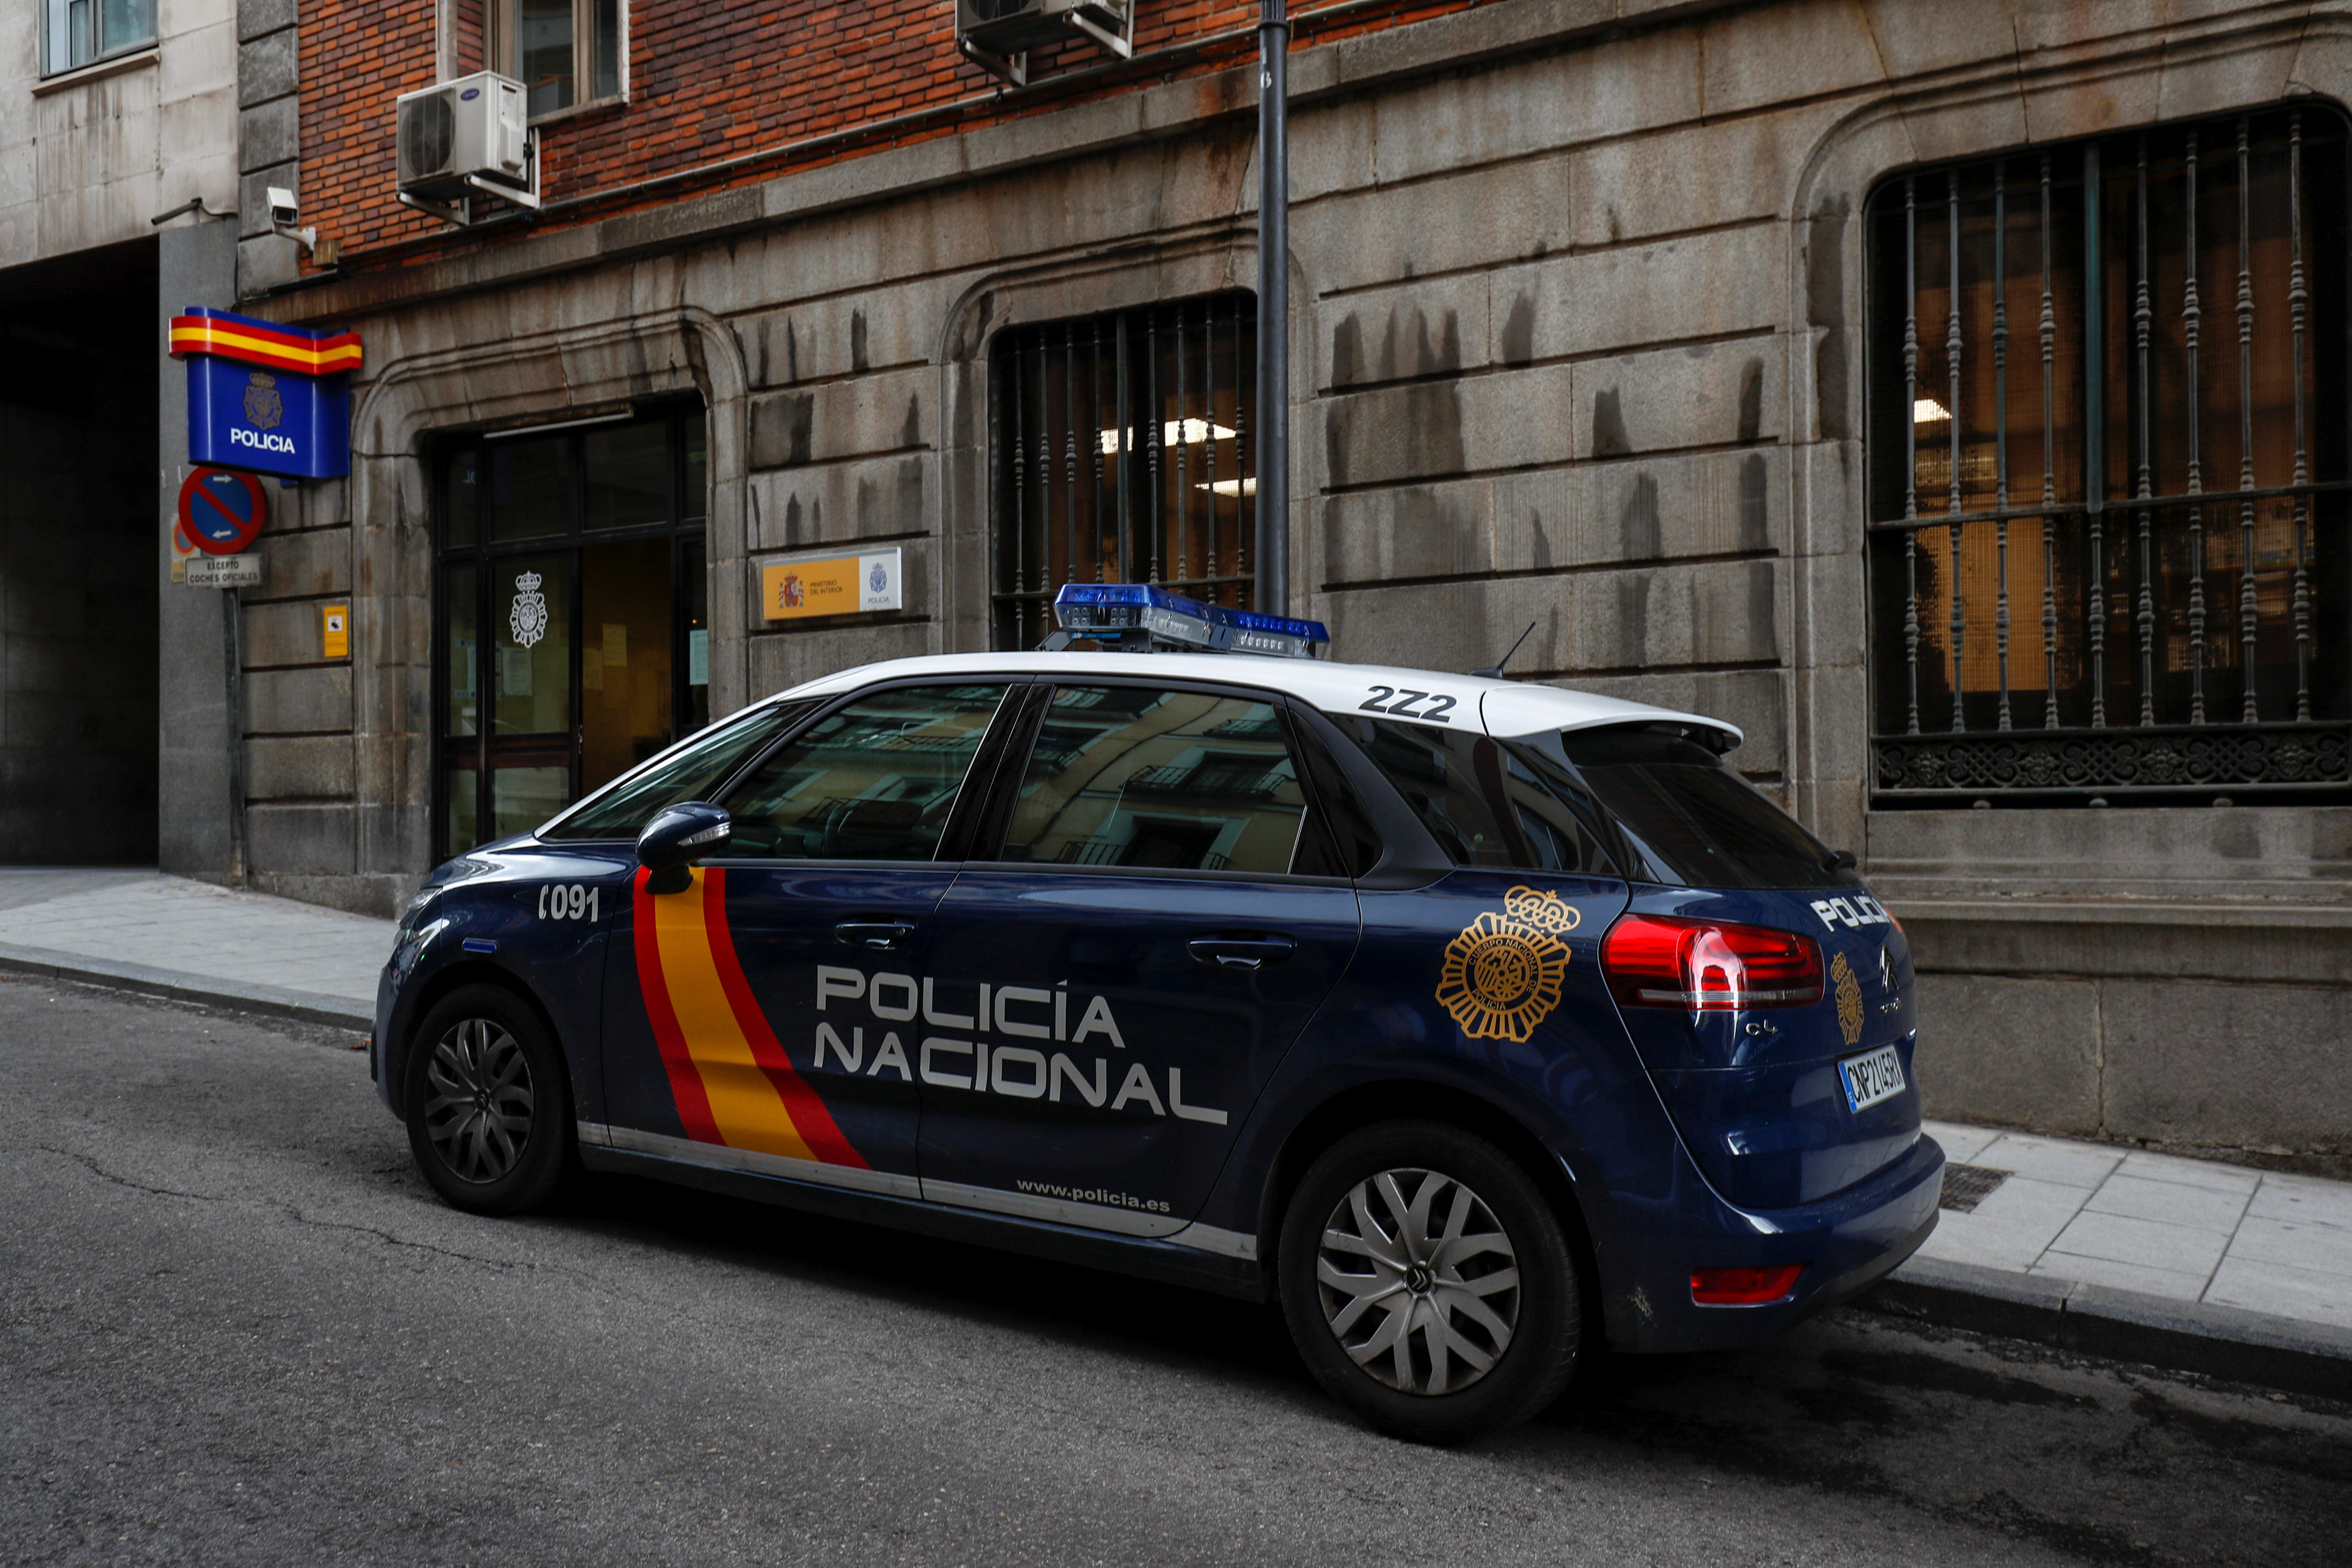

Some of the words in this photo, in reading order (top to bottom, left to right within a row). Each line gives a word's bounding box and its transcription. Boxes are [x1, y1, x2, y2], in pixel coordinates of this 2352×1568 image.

[230, 427, 296, 454] POLICIA
[190, 573, 219, 583] COCHES
[222, 572, 258, 582] OFICIALES
[207, 561, 239, 570] EXCEPTO
[810, 580, 837, 588] MINISTERIO
[810, 588, 818, 596] DEL
[821, 586, 843, 595] INTERIOR
[1358, 685, 1457, 723] 2Z2
[550, 884, 599, 922] 091
[1468, 939, 1503, 965] CUERPO
[1506, 939, 1538, 977] NACIONAL
[1526, 979, 1537, 994] DE
[816, 965, 1126, 1049] POLICÍA
[813, 1022, 1228, 1126] NACIONAL
[1016, 1178, 1171, 1213] www.policia.es
